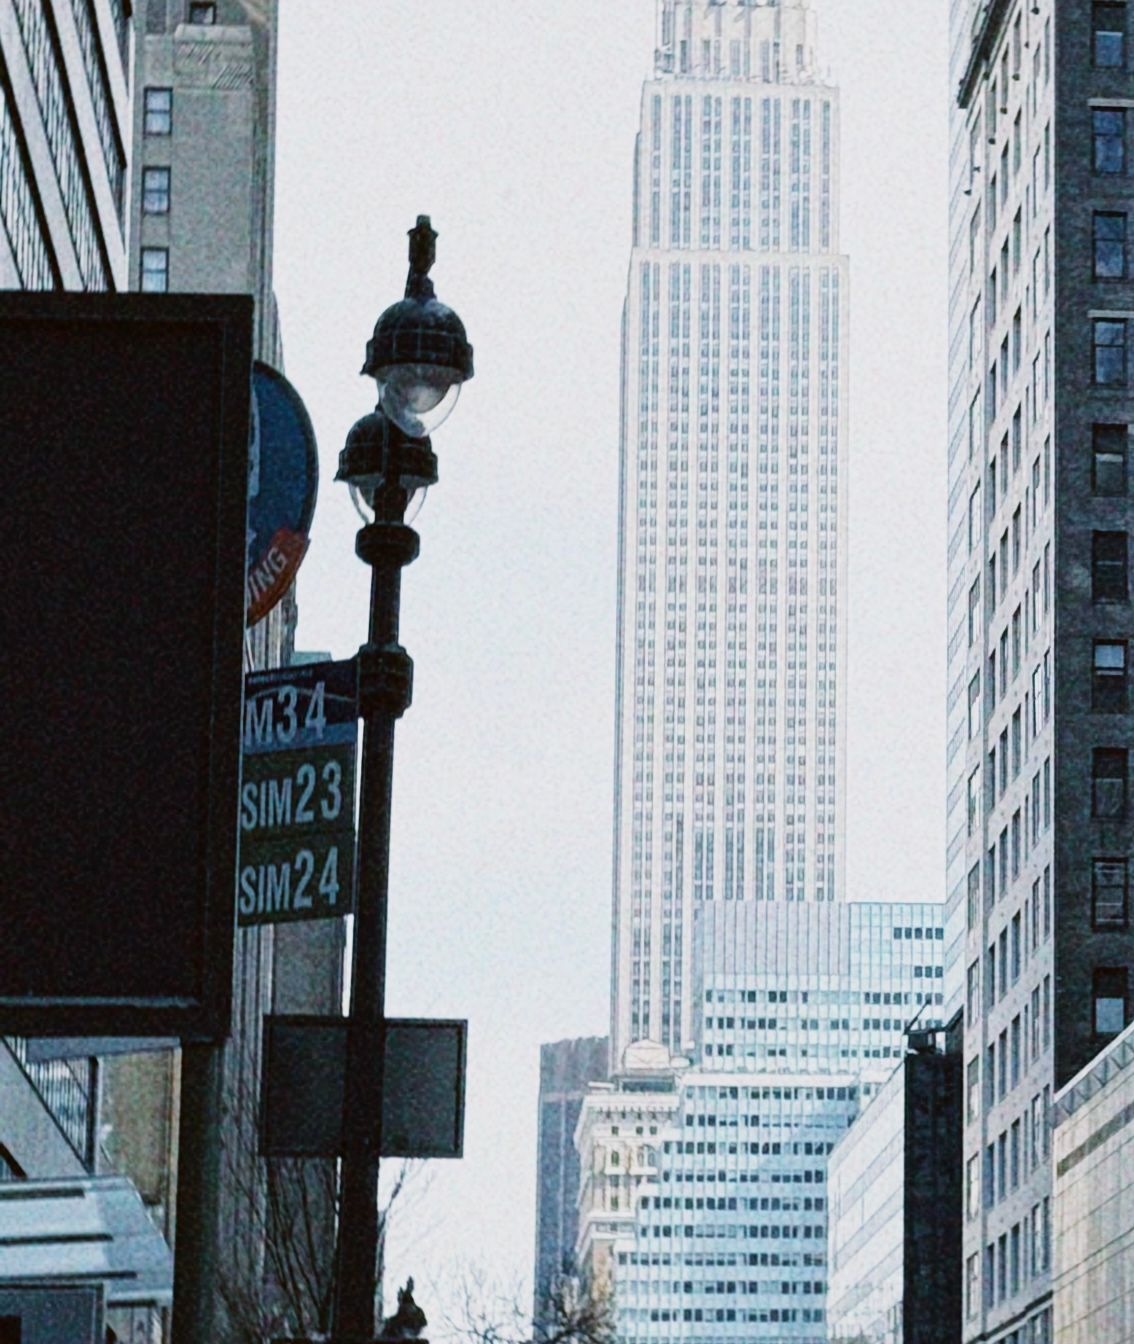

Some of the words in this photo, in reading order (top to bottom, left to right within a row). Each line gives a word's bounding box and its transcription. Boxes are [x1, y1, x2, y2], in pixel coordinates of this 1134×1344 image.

[248, 546, 288, 604] ING
[245, 681, 327, 747] M34
[241, 760, 342, 832] SIM23
[240, 845, 340, 915] SIM24
